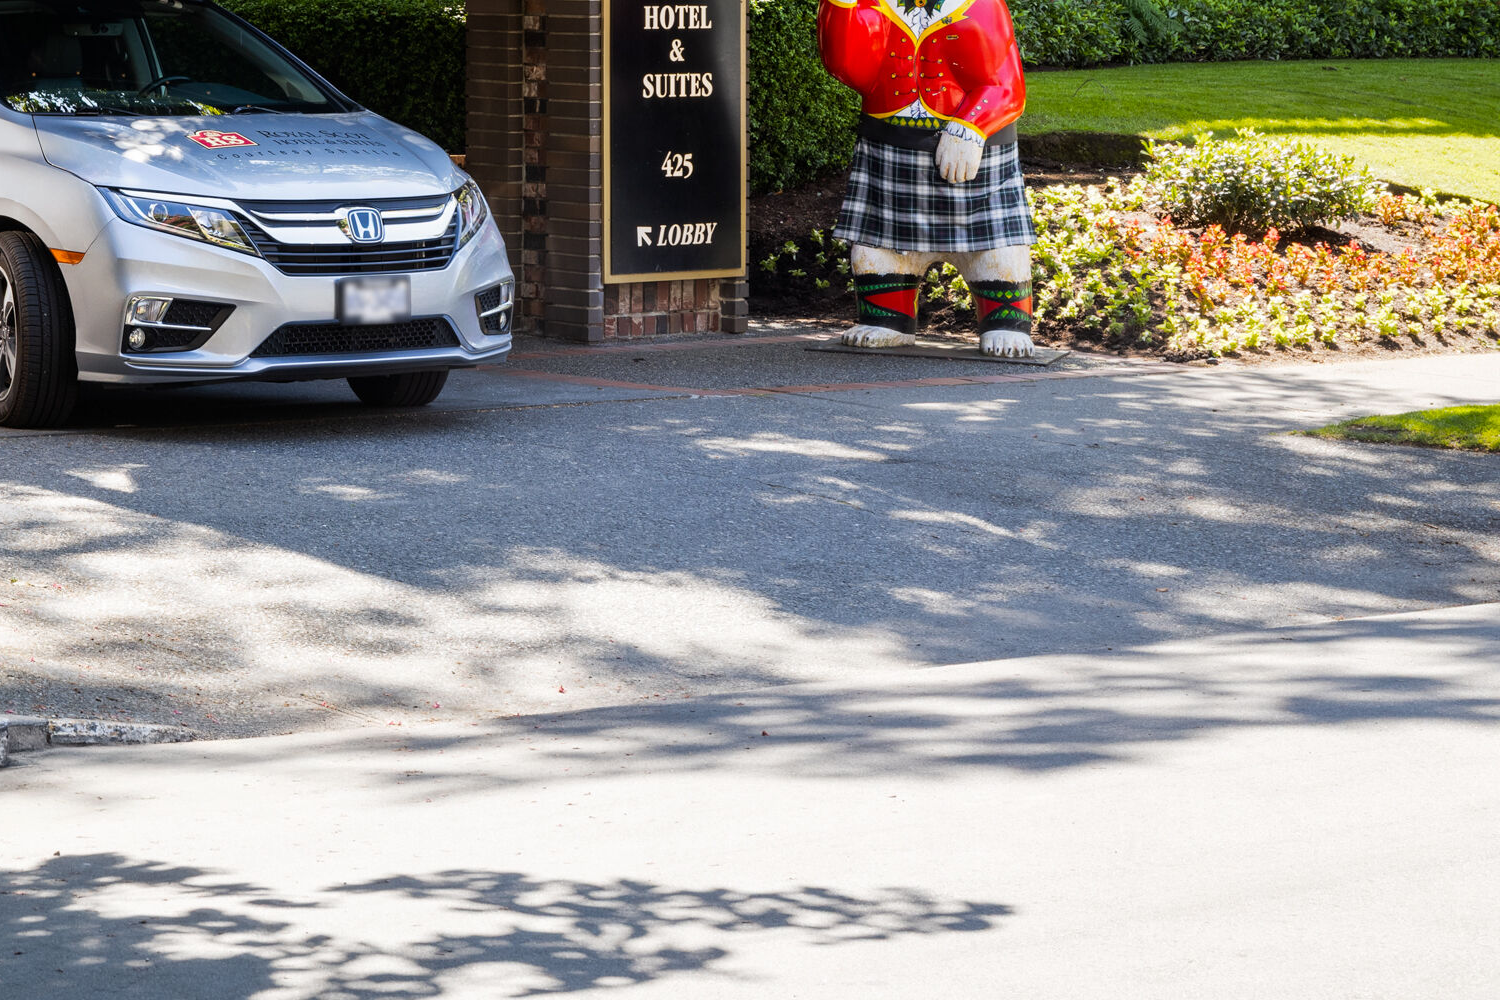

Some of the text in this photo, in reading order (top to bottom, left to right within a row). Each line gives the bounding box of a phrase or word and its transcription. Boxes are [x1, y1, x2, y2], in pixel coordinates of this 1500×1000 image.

[644, 5, 712, 29] HOTEL
[670, 39, 684, 61] &
[643, 73, 712, 98] SUITES
[662, 151, 693, 178] 425
[657, 223, 717, 246] LOBBY
